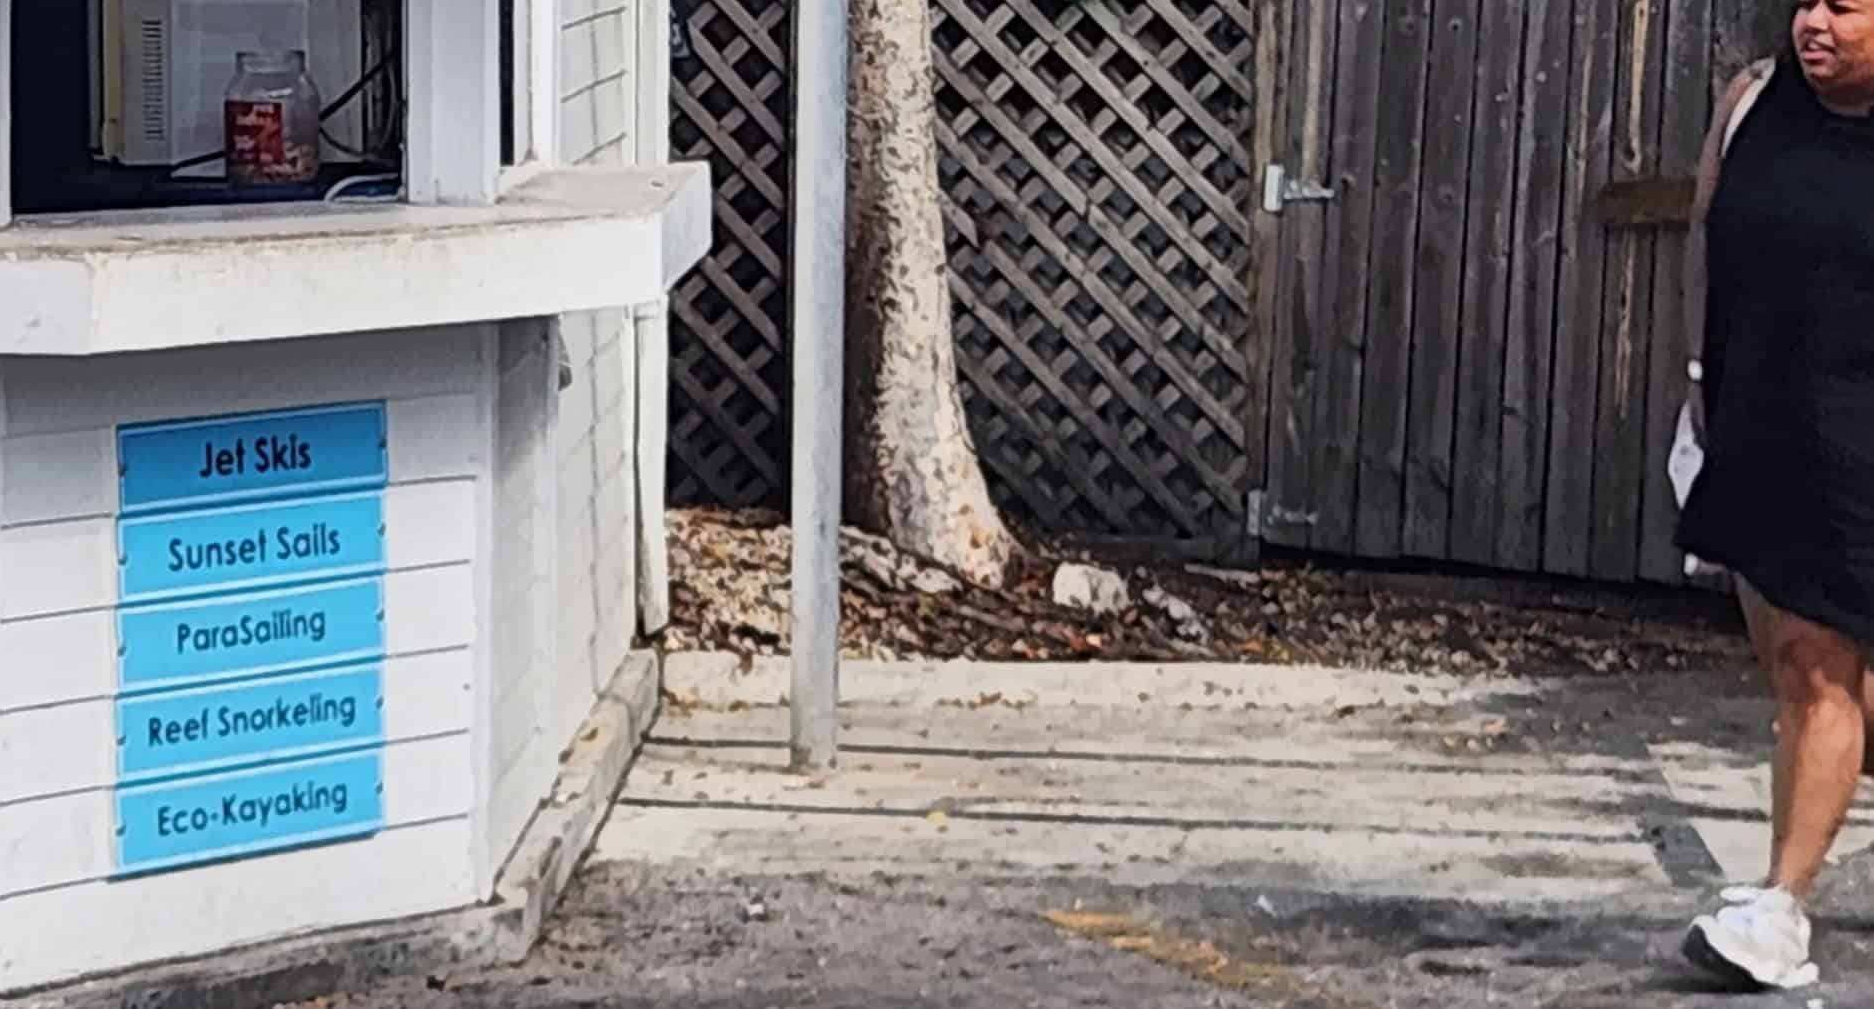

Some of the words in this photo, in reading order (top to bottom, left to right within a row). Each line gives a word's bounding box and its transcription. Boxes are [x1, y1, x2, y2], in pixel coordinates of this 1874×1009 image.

[199, 438, 244, 479] Jet
[255, 433, 311, 473] Skis
[168, 532, 266, 572] Sunset
[277, 521, 341, 560] Sails
[176, 609, 326, 655] ParaSailing
[148, 710, 209, 748] Reef
[218, 693, 357, 738] Snorkeling
[157, 782, 348, 837] Eco-Kayaking
